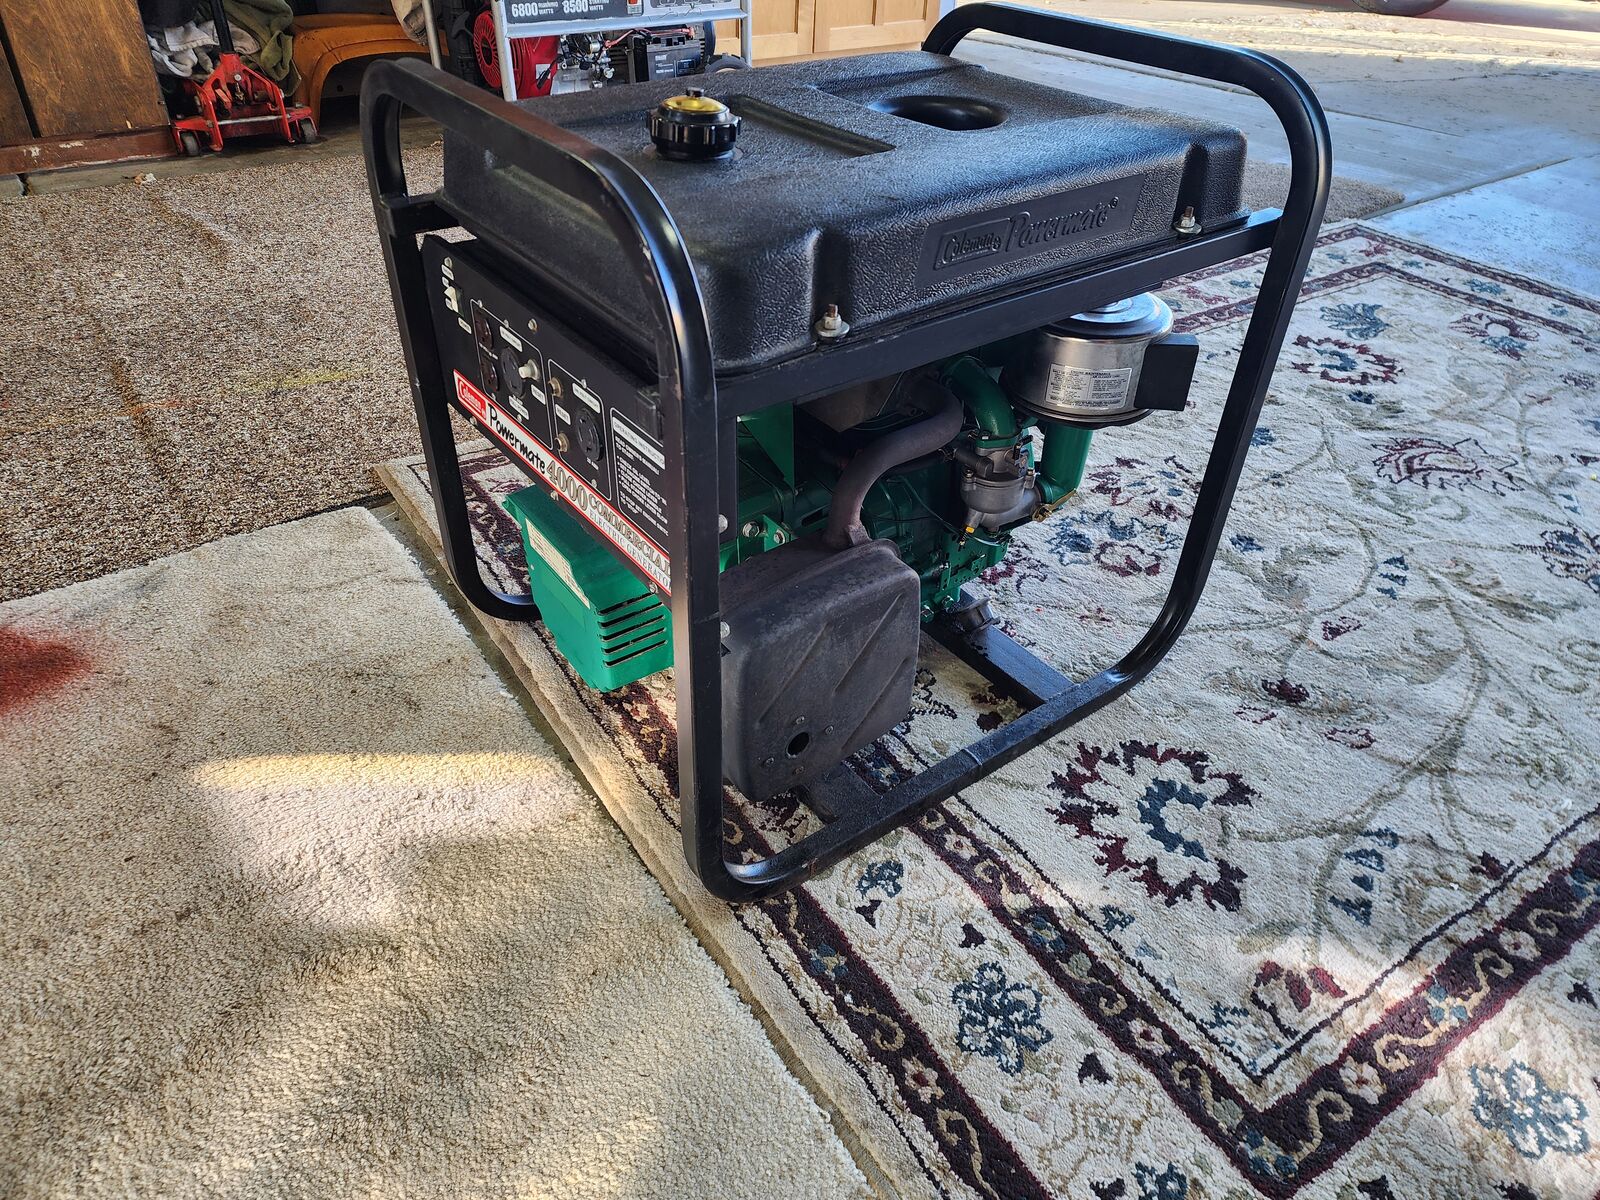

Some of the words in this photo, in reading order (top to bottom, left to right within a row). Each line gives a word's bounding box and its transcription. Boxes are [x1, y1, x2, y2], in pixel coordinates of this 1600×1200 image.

[511, 2, 538, 17] 6800
[562, 0, 588, 13] 8500
[943, 230, 1002, 264] Coleman
[1004, 202, 1108, 252] Powermate
[488, 403, 545, 475] Powermate
[547, 460, 588, 512] 4000
[589, 509, 625, 547] ELECTRIC
